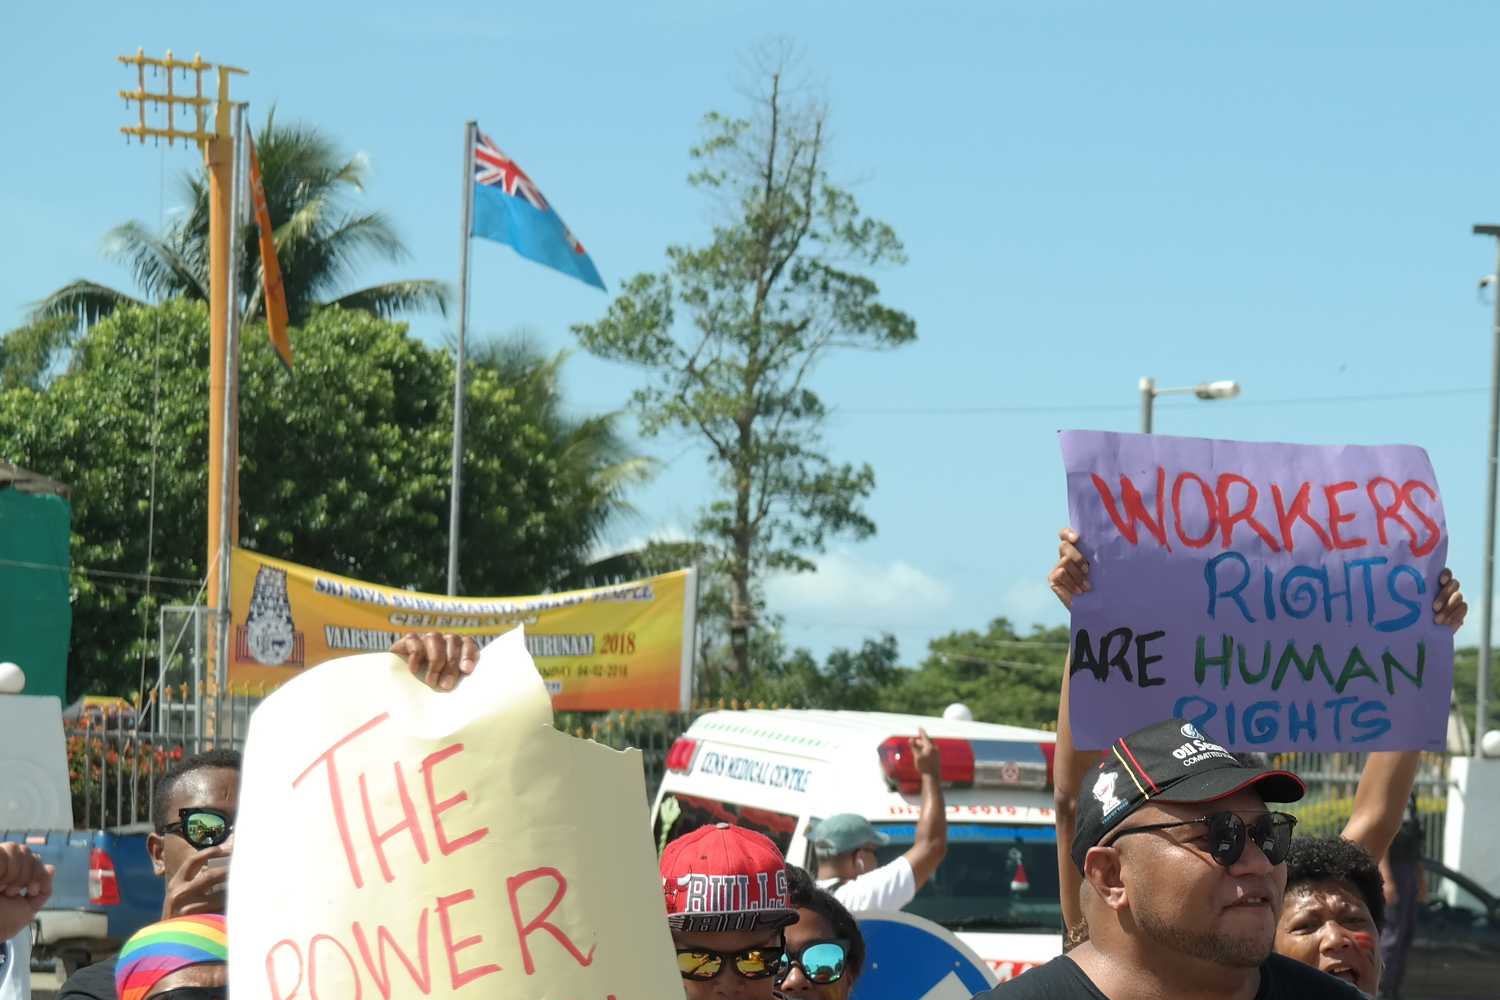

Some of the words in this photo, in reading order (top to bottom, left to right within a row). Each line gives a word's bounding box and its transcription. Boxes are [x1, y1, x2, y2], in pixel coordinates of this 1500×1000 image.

[1090, 465, 1441, 558] WORKERS
[1204, 551, 1427, 632] RIGHTS
[601, 631, 636, 655] 2018
[1070, 627, 1166, 688] ARE
[1194, 634, 1426, 694] HUMAN
[1173, 695, 1392, 745] RIGHTS
[292, 712, 489, 888] THE
[685, 870, 787, 912] BULLS
